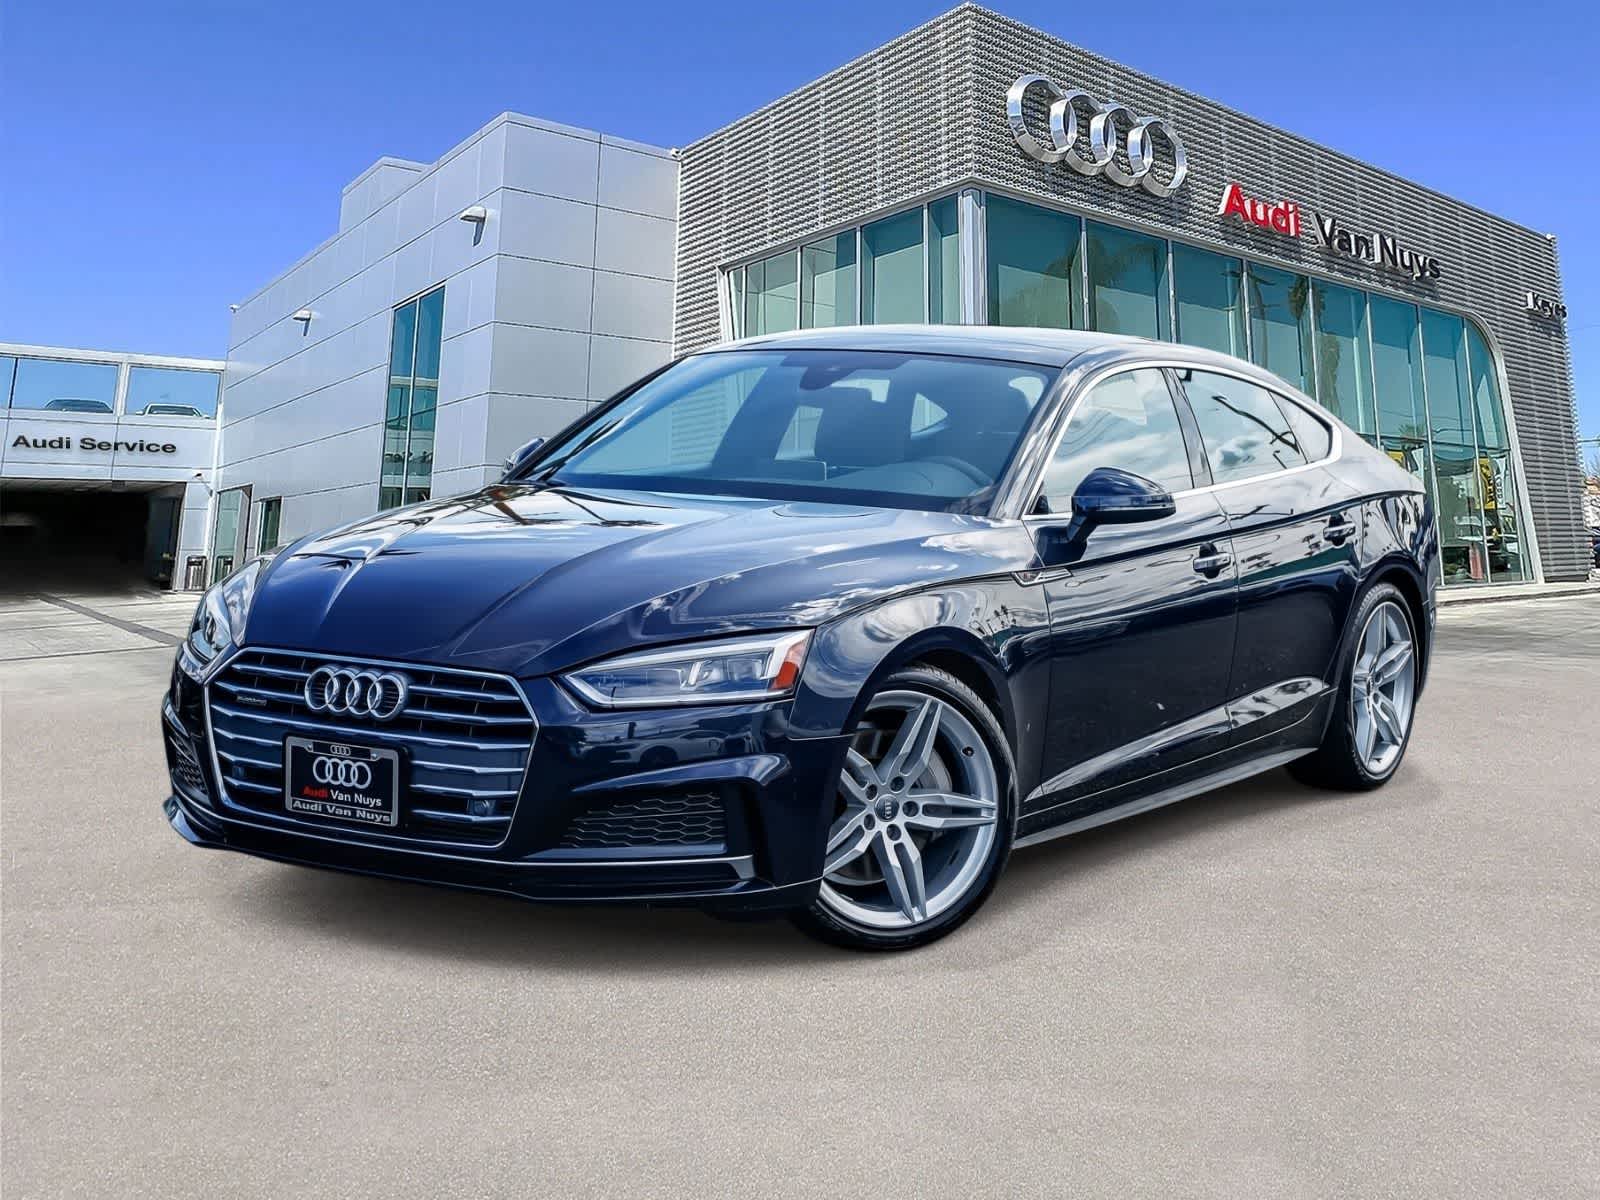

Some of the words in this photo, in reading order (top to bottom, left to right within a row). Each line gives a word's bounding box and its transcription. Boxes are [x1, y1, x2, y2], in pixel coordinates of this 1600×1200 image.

[1218, 183, 1301, 237] Audi
[1311, 212, 1370, 258] Van
[1373, 233, 1442, 280] Nuys
[12, 435, 71, 449] Audi
[80, 437, 177, 453] Service
[303, 786, 328, 798] Audi
[330, 789, 351, 802] Van
[354, 794, 382, 807] Nuys
[293, 800, 322, 812] Audi
[326, 804, 352, 817] Van
[356, 810, 391, 823] Nuys
